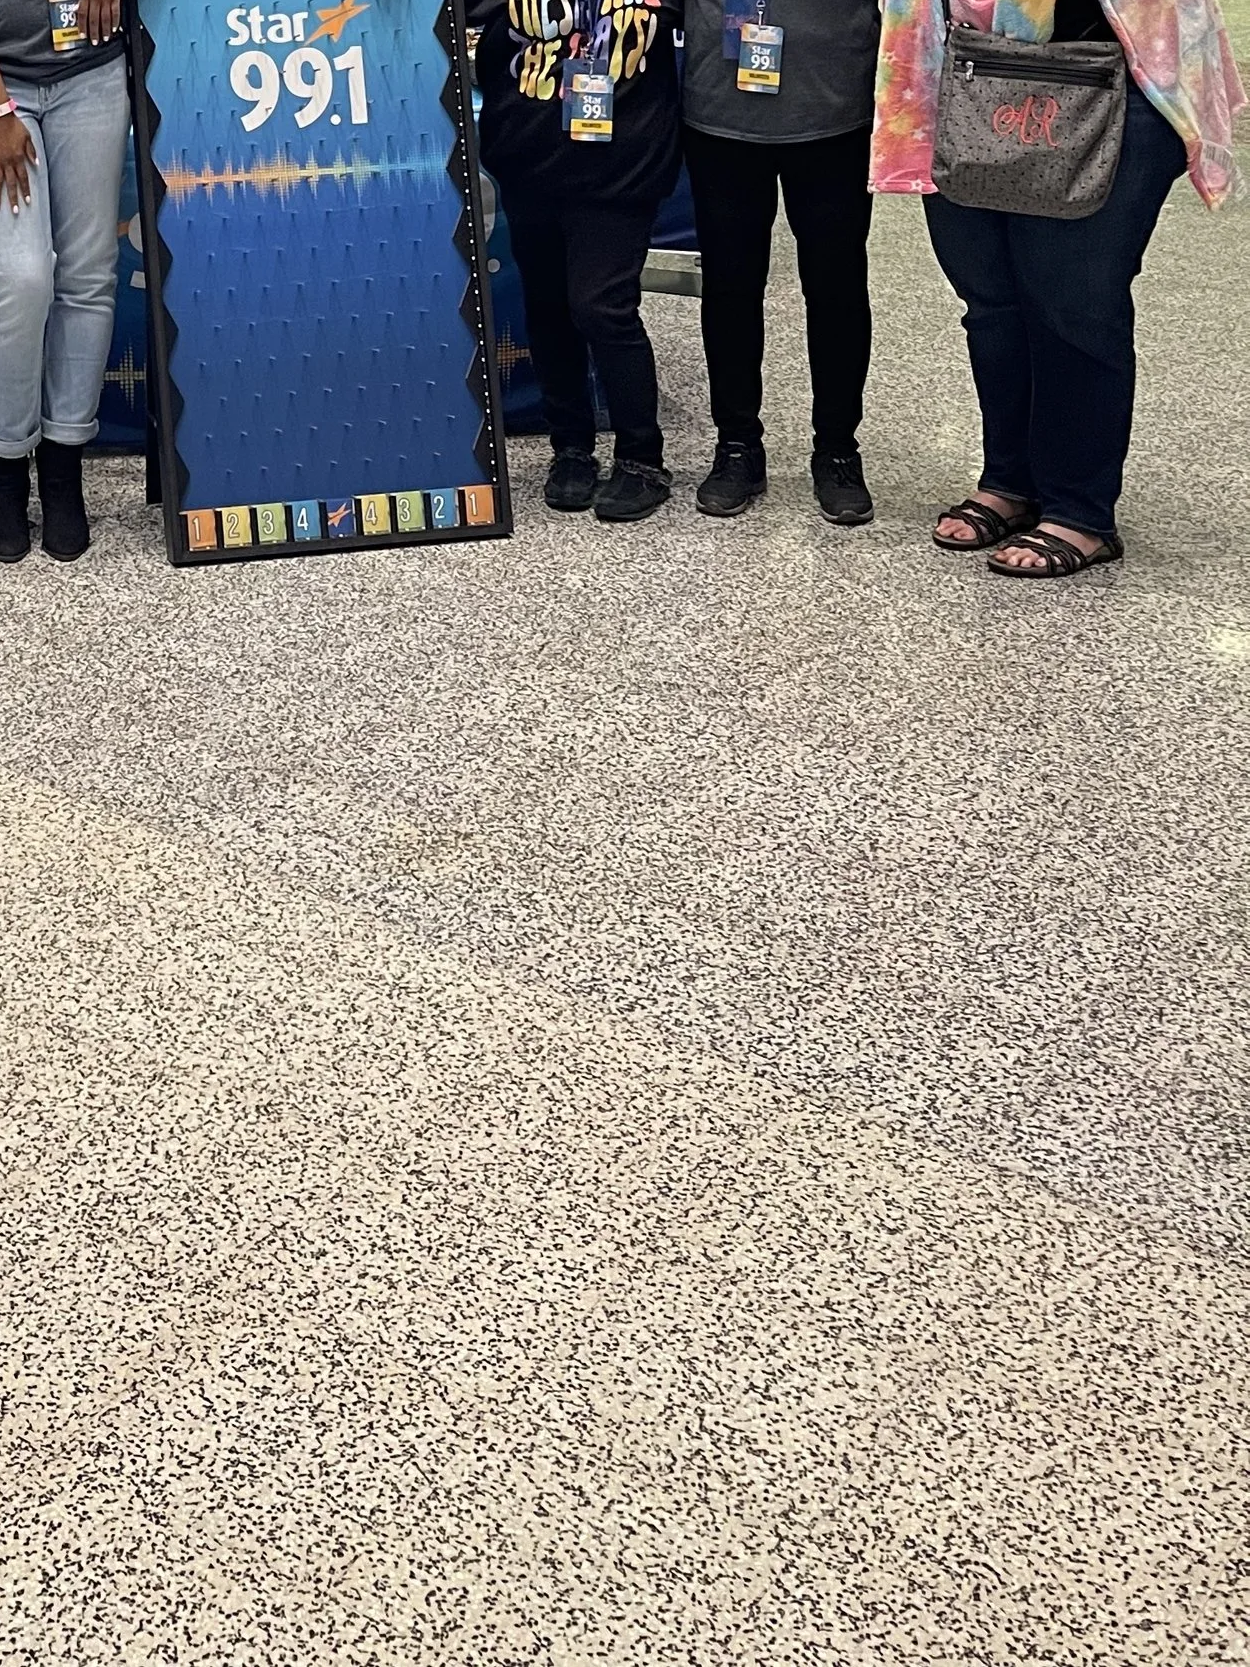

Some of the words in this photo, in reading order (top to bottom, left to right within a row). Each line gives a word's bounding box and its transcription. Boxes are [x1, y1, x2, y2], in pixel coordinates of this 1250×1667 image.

[226, 5, 309, 46] Star
[230, 45, 368, 132] 99.1
[191, 517, 202, 541] 1
[227, 513, 240, 538] 2
[261, 510, 274, 534] 3
[296, 506, 309, 531] 4
[365, 501, 378, 525] 4
[399, 498, 411, 522] 3
[433, 495, 446, 519] 2
[468, 492, 479, 516] 1
